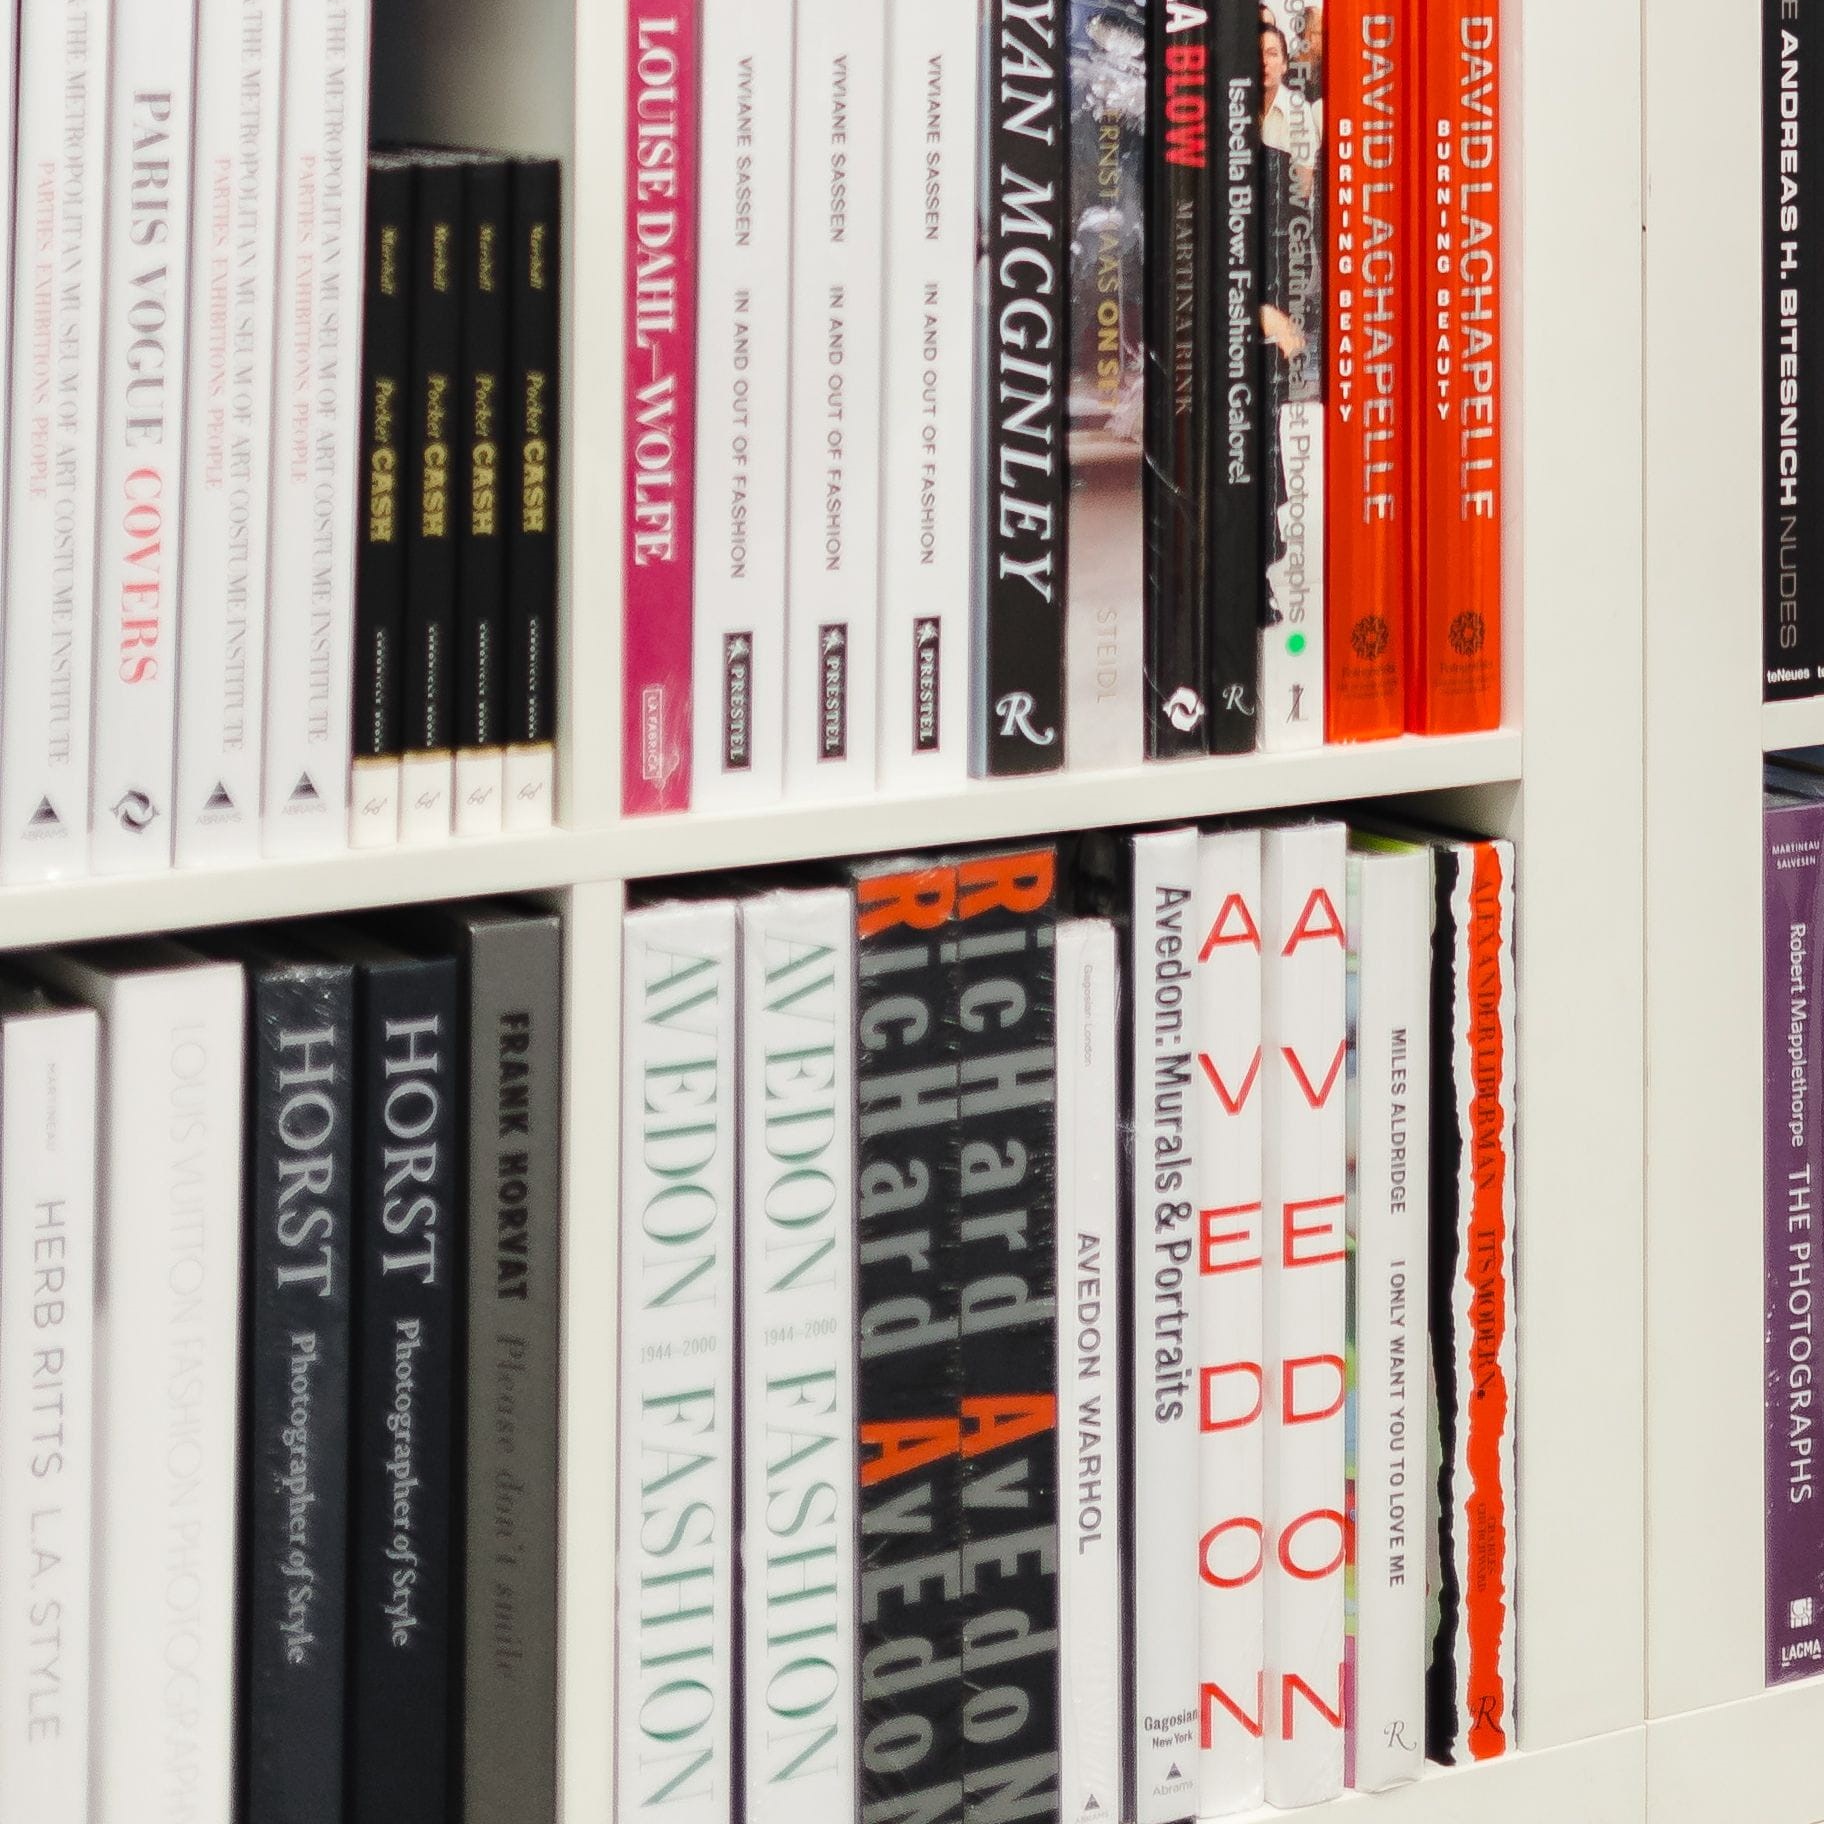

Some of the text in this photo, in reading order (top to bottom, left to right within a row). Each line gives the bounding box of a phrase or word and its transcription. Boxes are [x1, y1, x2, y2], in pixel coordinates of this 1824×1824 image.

[637, 16, 678, 201] LOUISE
[1165, 44, 1206, 167] BLOW
[1226, 78, 1252, 484] Isabella Blow: Fashion Galore!
[1460, 15, 1493, 519] DAVID LACHAPELLE
[118, 88, 174, 686] PARIS VOGUE COVERS
[522, 440, 548, 531] CASH
[917, 54, 942, 742] VIVIANE SASSEN IN AND OUT OF FASHION PRESTEL
[998, 165, 1052, 601] MCGINLEY
[497, 1011, 530, 1301] FRANK HORVAT
[1154, 886, 1191, 1423] Avedon: Murals & Portraits
[1388, 1028, 1408, 1214] MILES ALDRIDGE
[1783, 924, 1813, 1503] Robert Mapplethorpe THE PHOTOGRAPHS
[276, 1025, 336, 1664] HORST Photographer of Style
[762, 932, 839, 1782] AVEDON FASHION
[1077, 1232, 1102, 1555] AVEDON WARHOL
